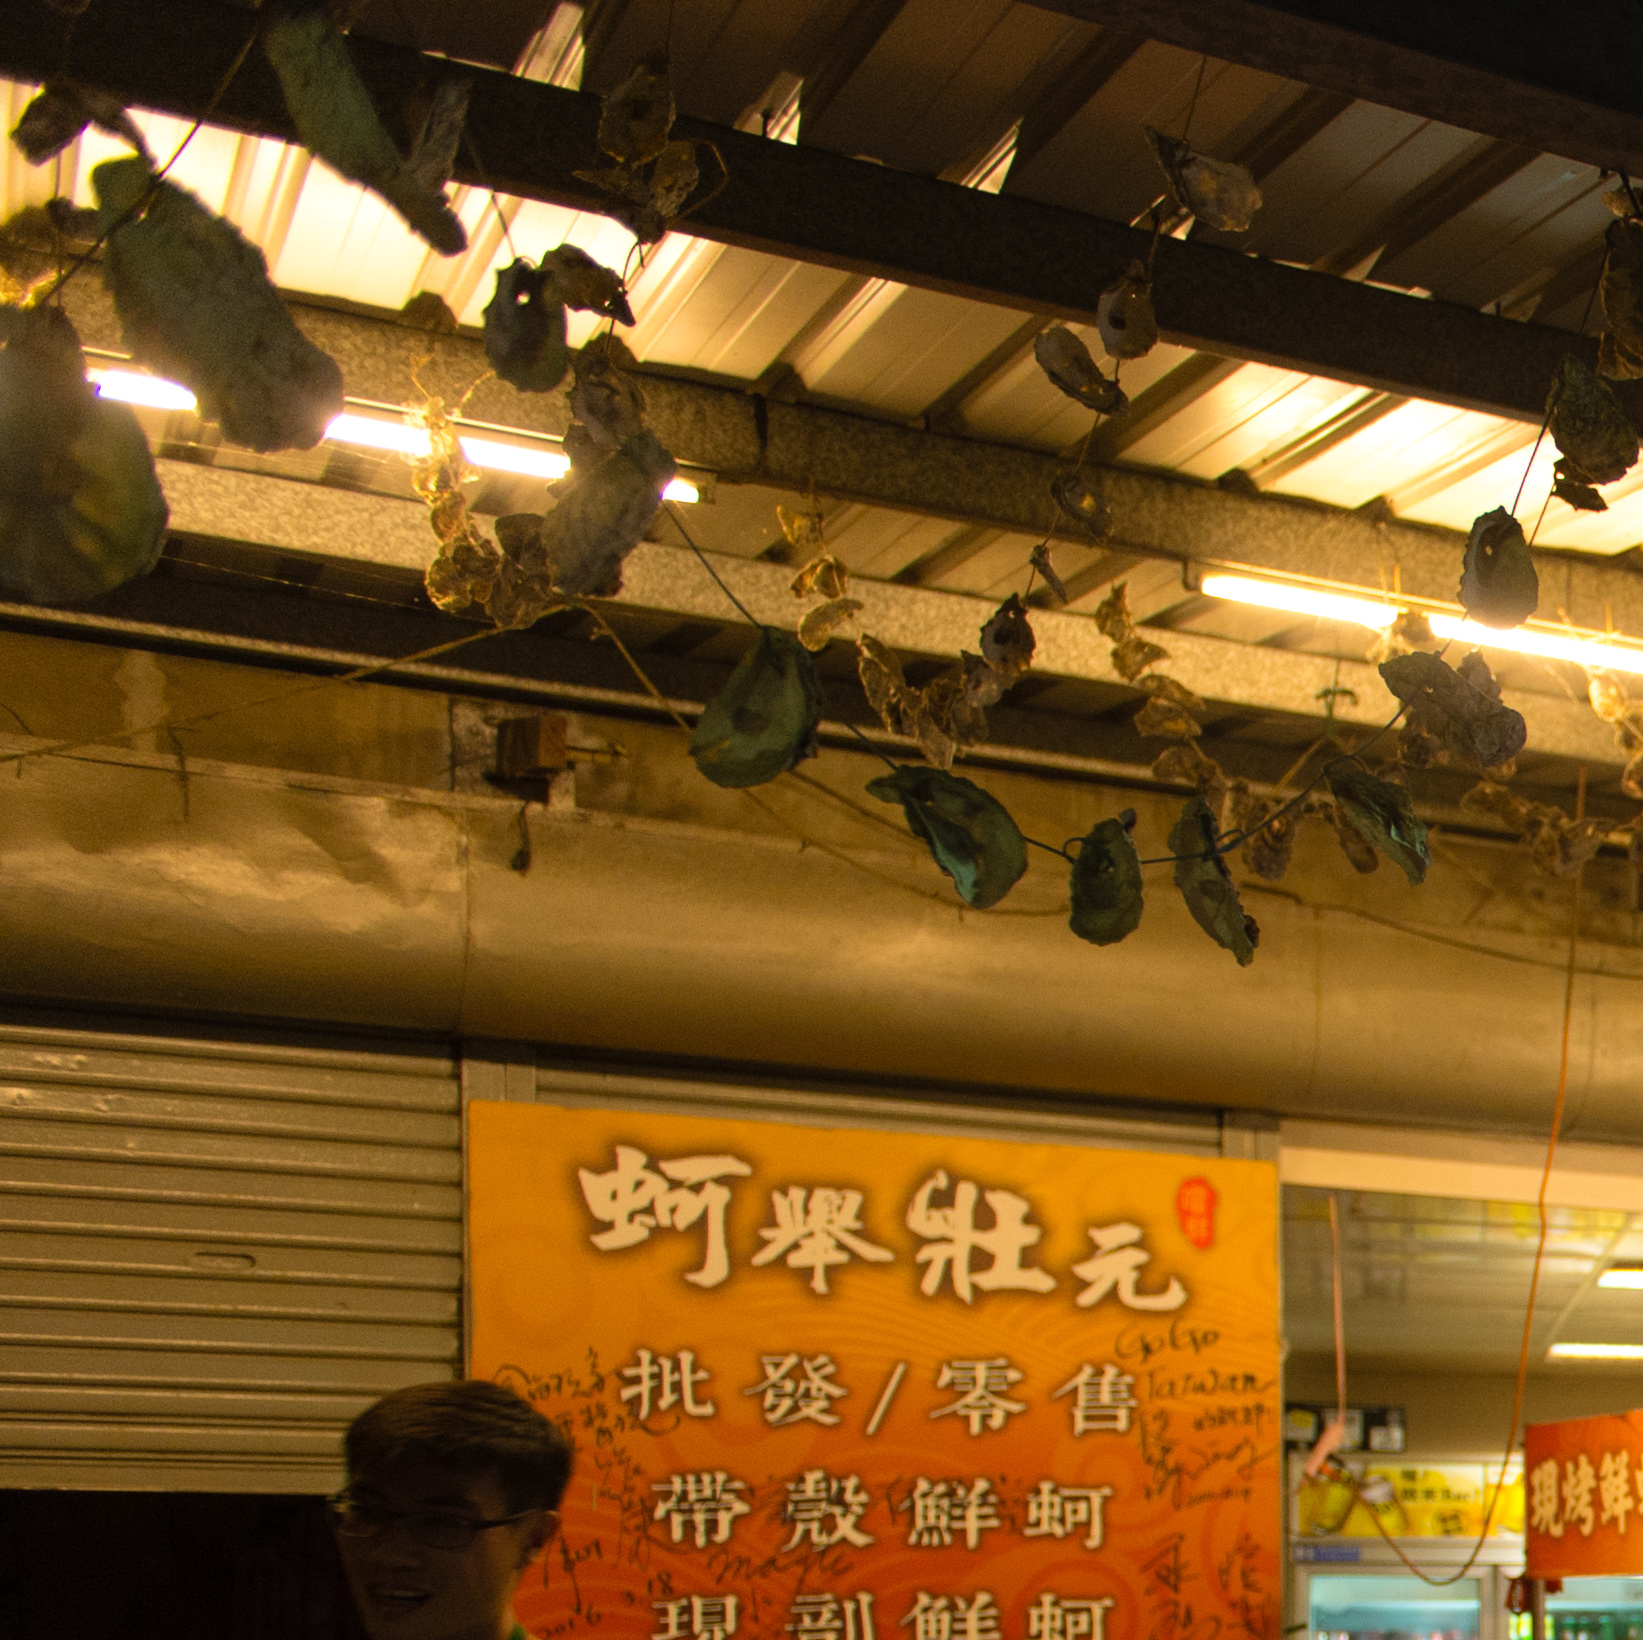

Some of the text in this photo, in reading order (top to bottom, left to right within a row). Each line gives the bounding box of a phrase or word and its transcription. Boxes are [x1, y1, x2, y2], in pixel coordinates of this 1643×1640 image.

[577, 1144, 1188, 1311] 蚵舉壯元
[619, 1348, 1140, 1437] 批發/零售
[652, 1467, 1115, 1553] 帶殼鮮蚵
